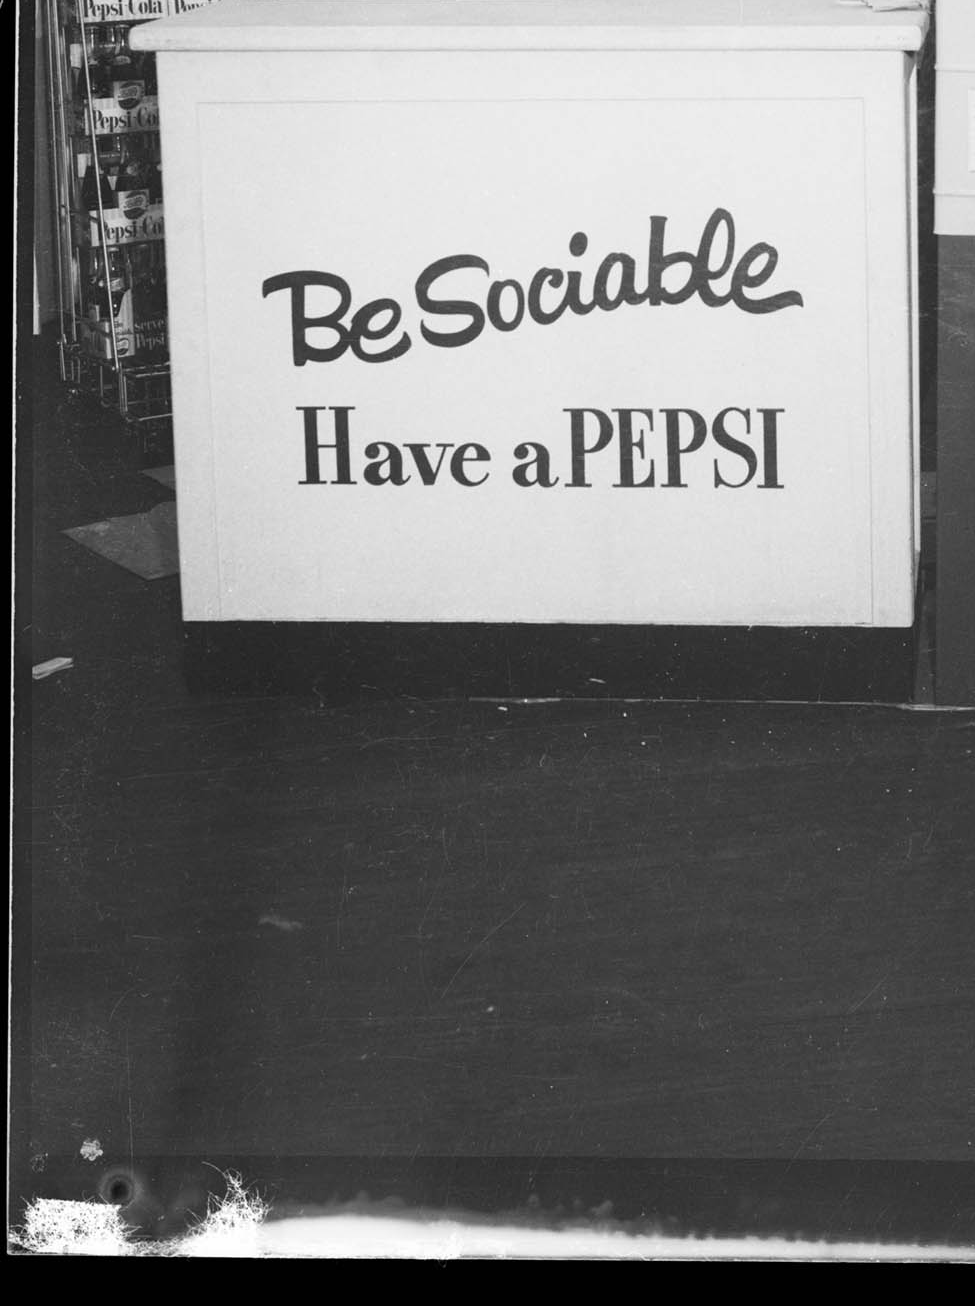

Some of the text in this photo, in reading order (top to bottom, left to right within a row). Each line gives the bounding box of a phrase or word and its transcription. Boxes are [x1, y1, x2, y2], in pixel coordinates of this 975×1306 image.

[262, 208, 803, 366] Be Sociable
[296, 406, 785, 489] Have a PEPSI
